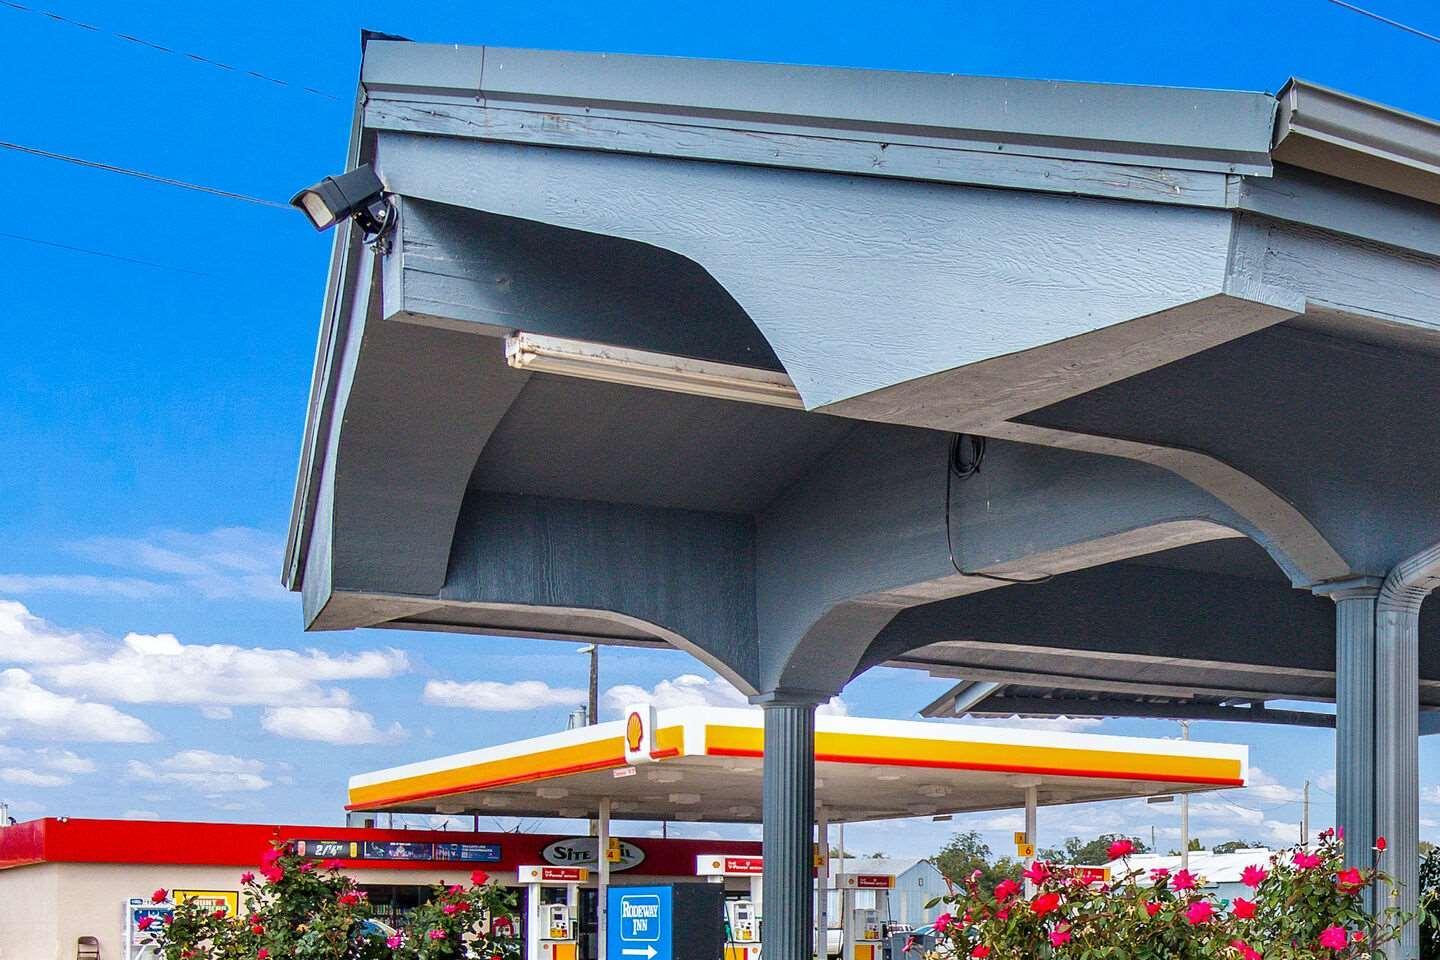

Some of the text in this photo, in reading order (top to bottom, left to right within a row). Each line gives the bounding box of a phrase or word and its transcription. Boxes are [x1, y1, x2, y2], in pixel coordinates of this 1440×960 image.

[1025, 847, 1032, 856] 6
[622, 901, 659, 918] RODEWAY
[633, 919, 648, 936] INN
